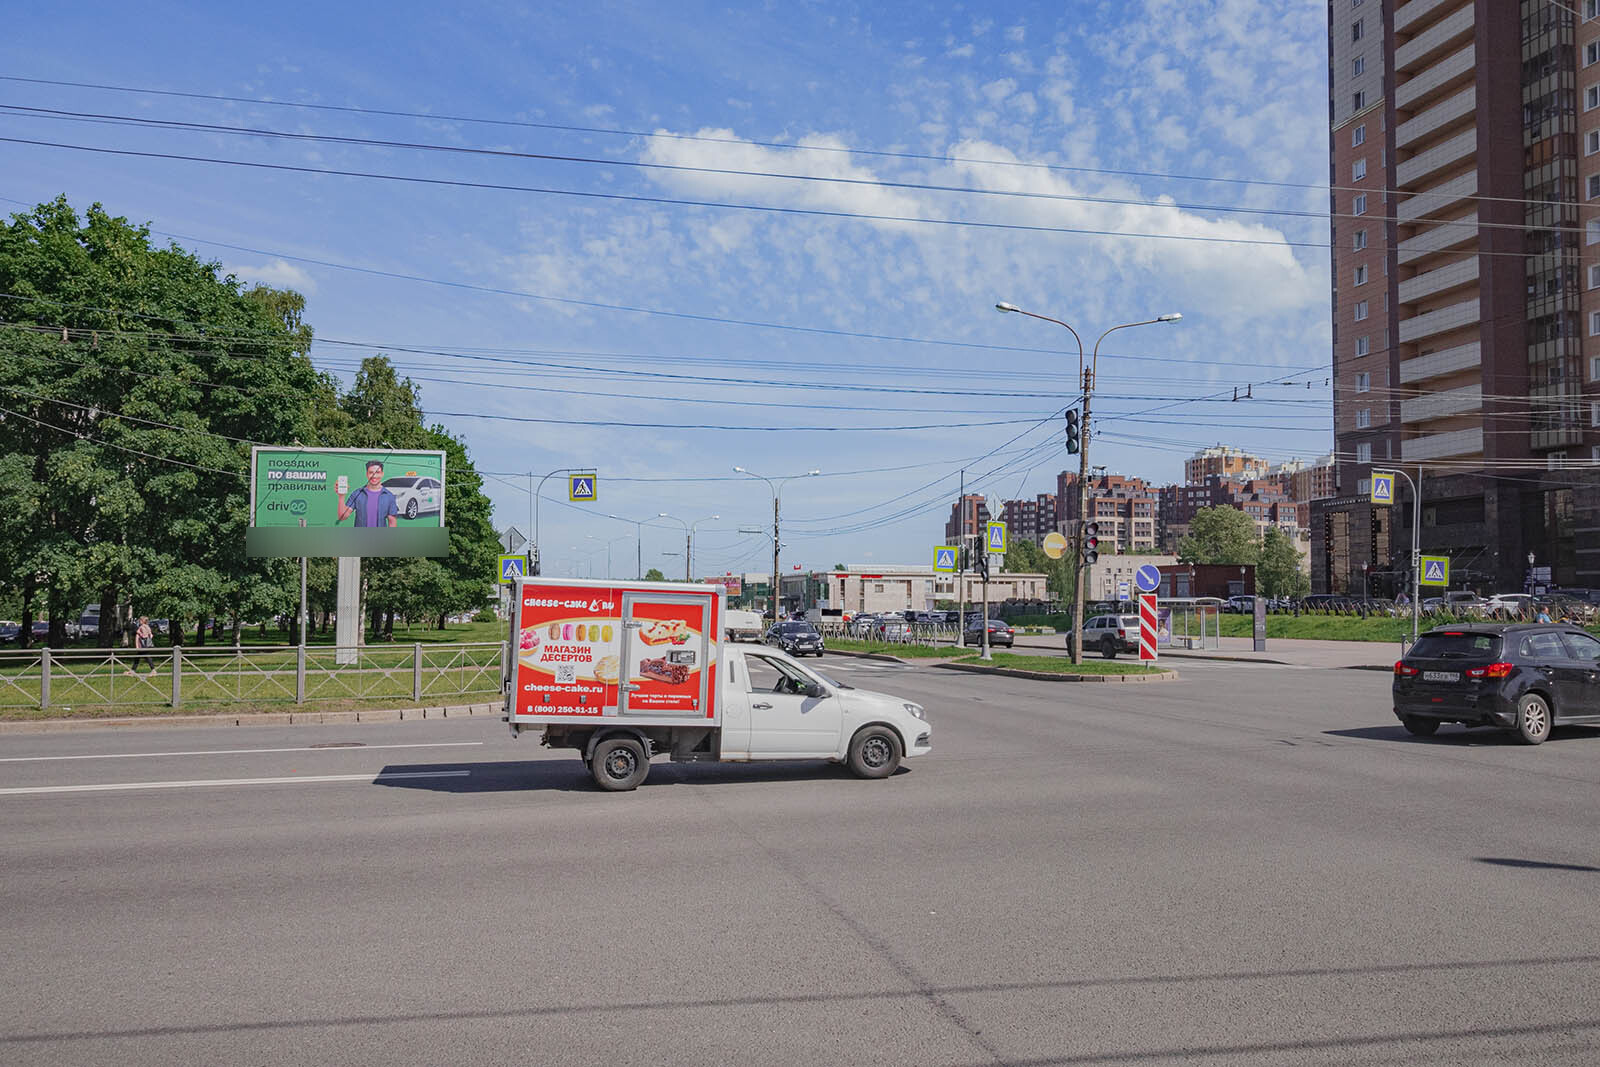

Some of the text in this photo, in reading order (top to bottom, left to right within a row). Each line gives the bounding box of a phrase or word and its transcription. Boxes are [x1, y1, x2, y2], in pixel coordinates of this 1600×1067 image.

[268, 460, 320, 468] поездки
[268, 471, 326, 480] по вашим
[268, 483, 326, 492] правилам
[544, 645, 592, 654] МАГАЗИН
[540, 654, 592, 662] ДЕСЕРТОВ
[524, 683, 603, 693] cheese-cake.ru
